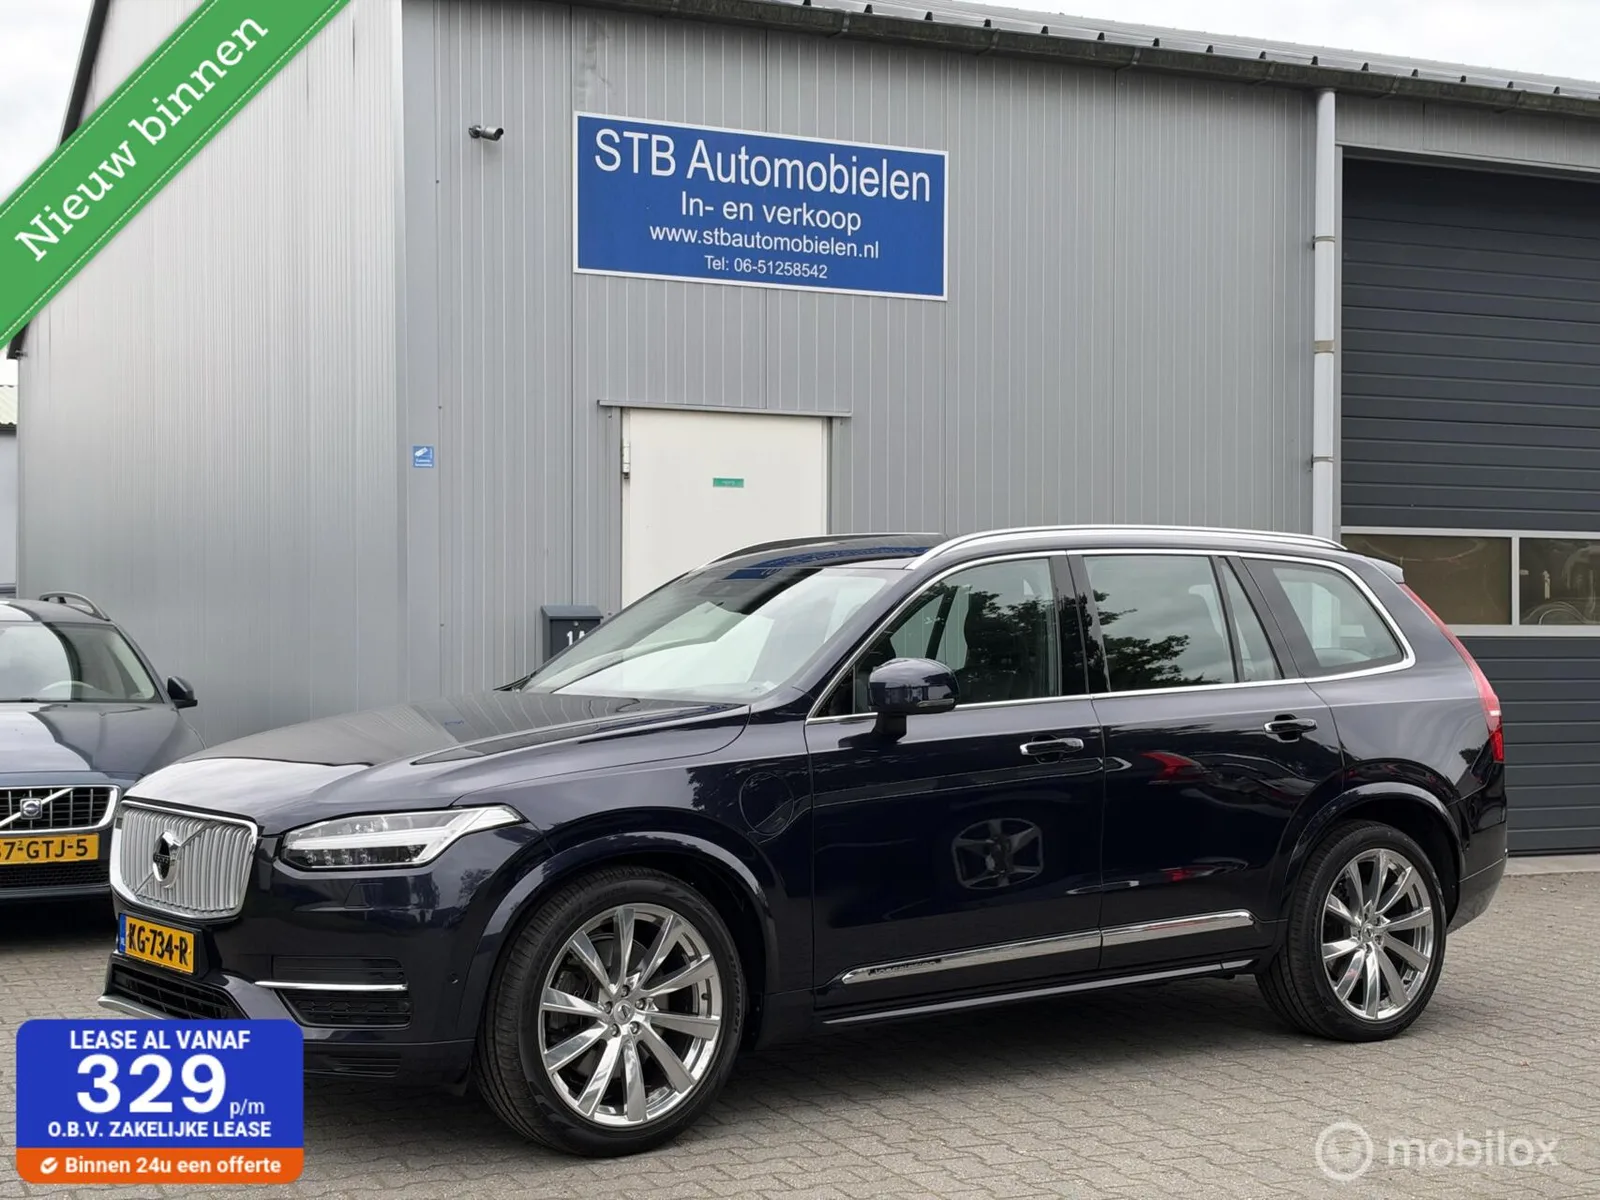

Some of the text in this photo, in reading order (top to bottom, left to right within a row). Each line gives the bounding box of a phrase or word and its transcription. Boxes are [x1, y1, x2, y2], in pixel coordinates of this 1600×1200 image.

[594, 128, 931, 203] STB Automobielen
[681, 190, 862, 236] In- en verkoop
[649, 225, 880, 260] www.stbautomobielen.nl
[704, 255, 828, 280] Tel: 06-51258542
[0, 838, 89, 860] 7-GTJ-5
[128, 923, 189, 967] KG-734-R
